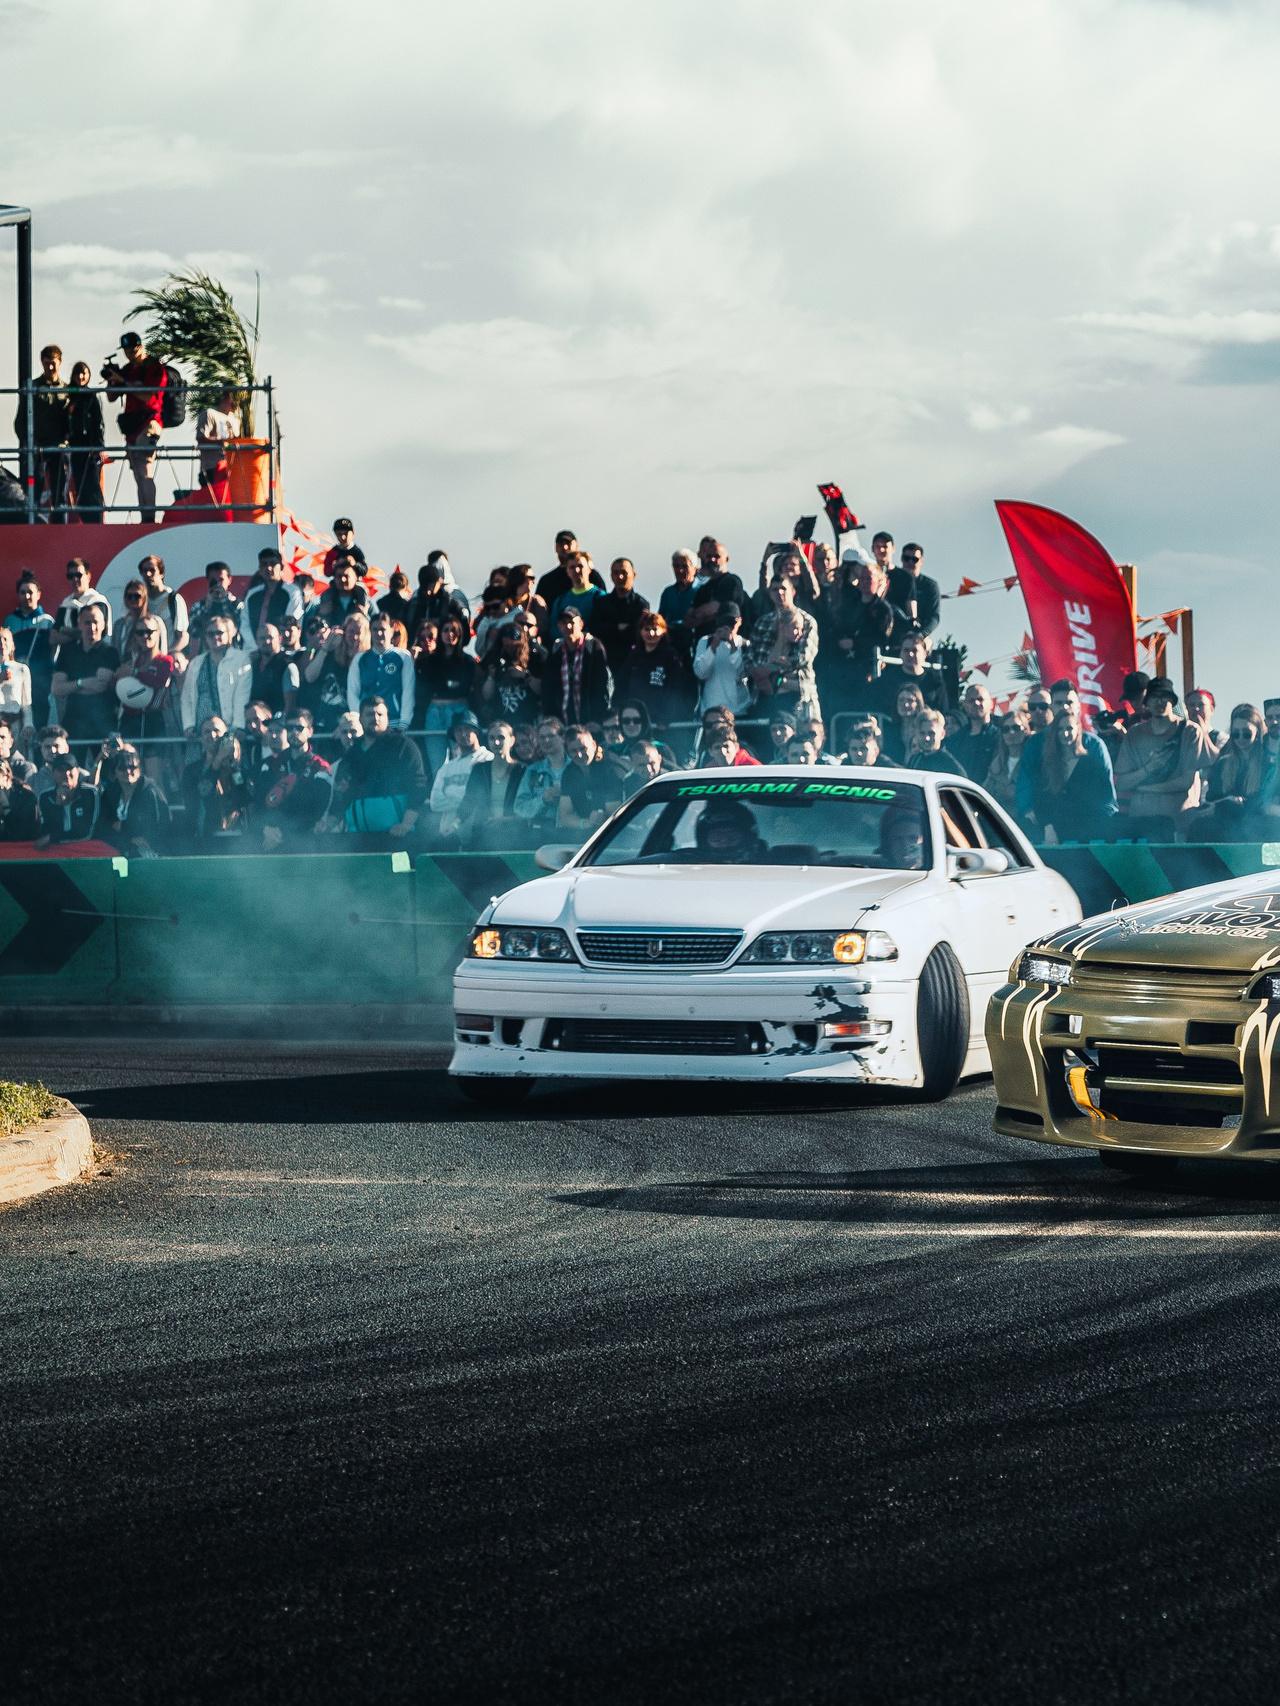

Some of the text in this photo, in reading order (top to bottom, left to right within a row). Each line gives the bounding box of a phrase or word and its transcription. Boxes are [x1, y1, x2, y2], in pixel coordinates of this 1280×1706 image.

[677, 783, 897, 800] TSUNAMI PICNIC
[1140, 923, 1270, 939] MOTOR OIL
